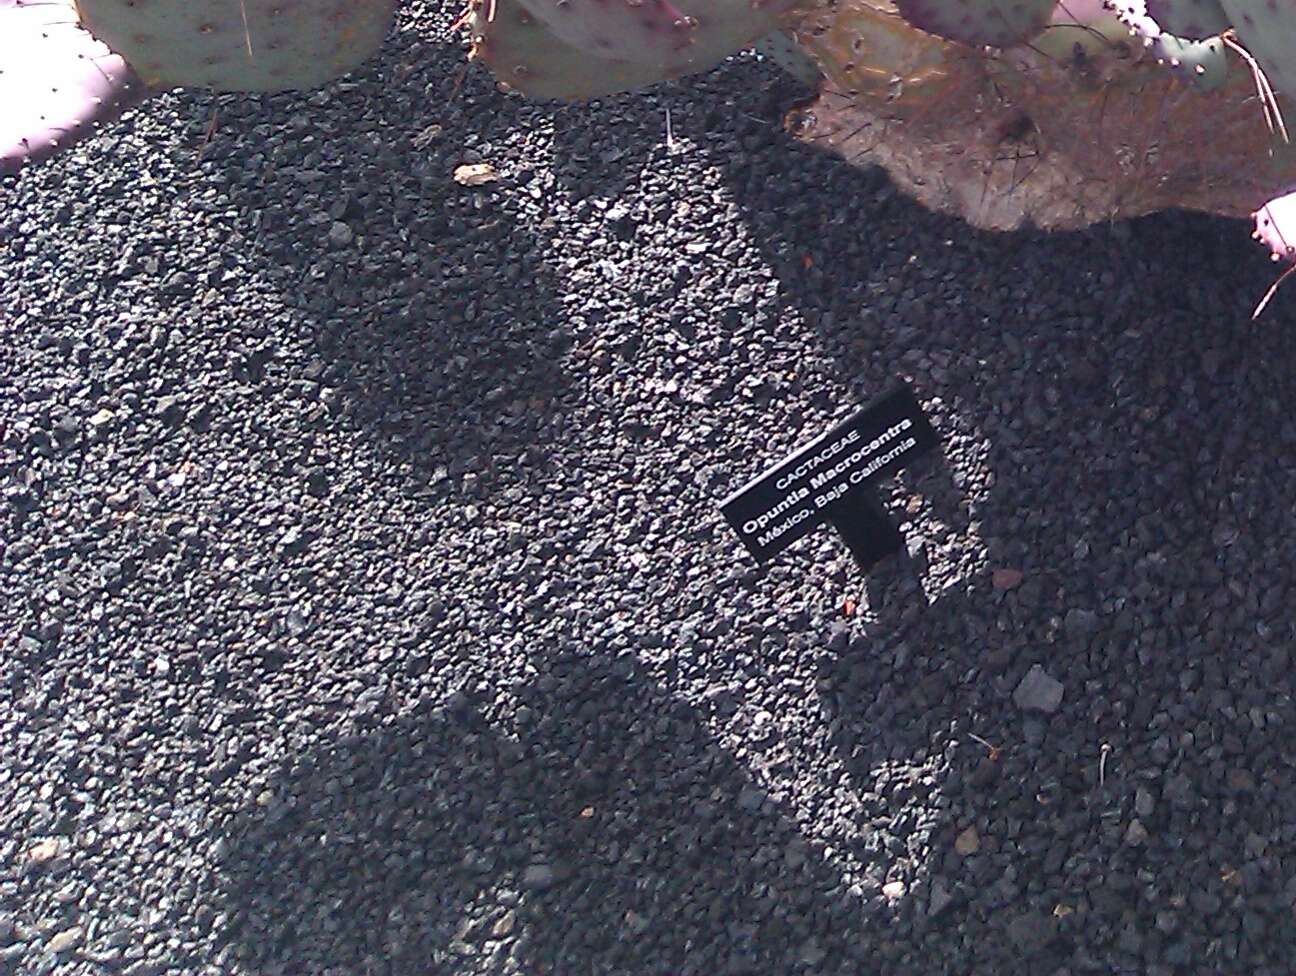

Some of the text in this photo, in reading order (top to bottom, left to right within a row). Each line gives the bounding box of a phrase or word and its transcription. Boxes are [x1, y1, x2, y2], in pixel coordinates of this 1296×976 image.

[742, 418, 913, 534] Opuntia Macrocentra
[776, 430, 861, 490] CACTACEAE
[814, 482, 849, 509] Baja
[850, 436, 916, 485] California
